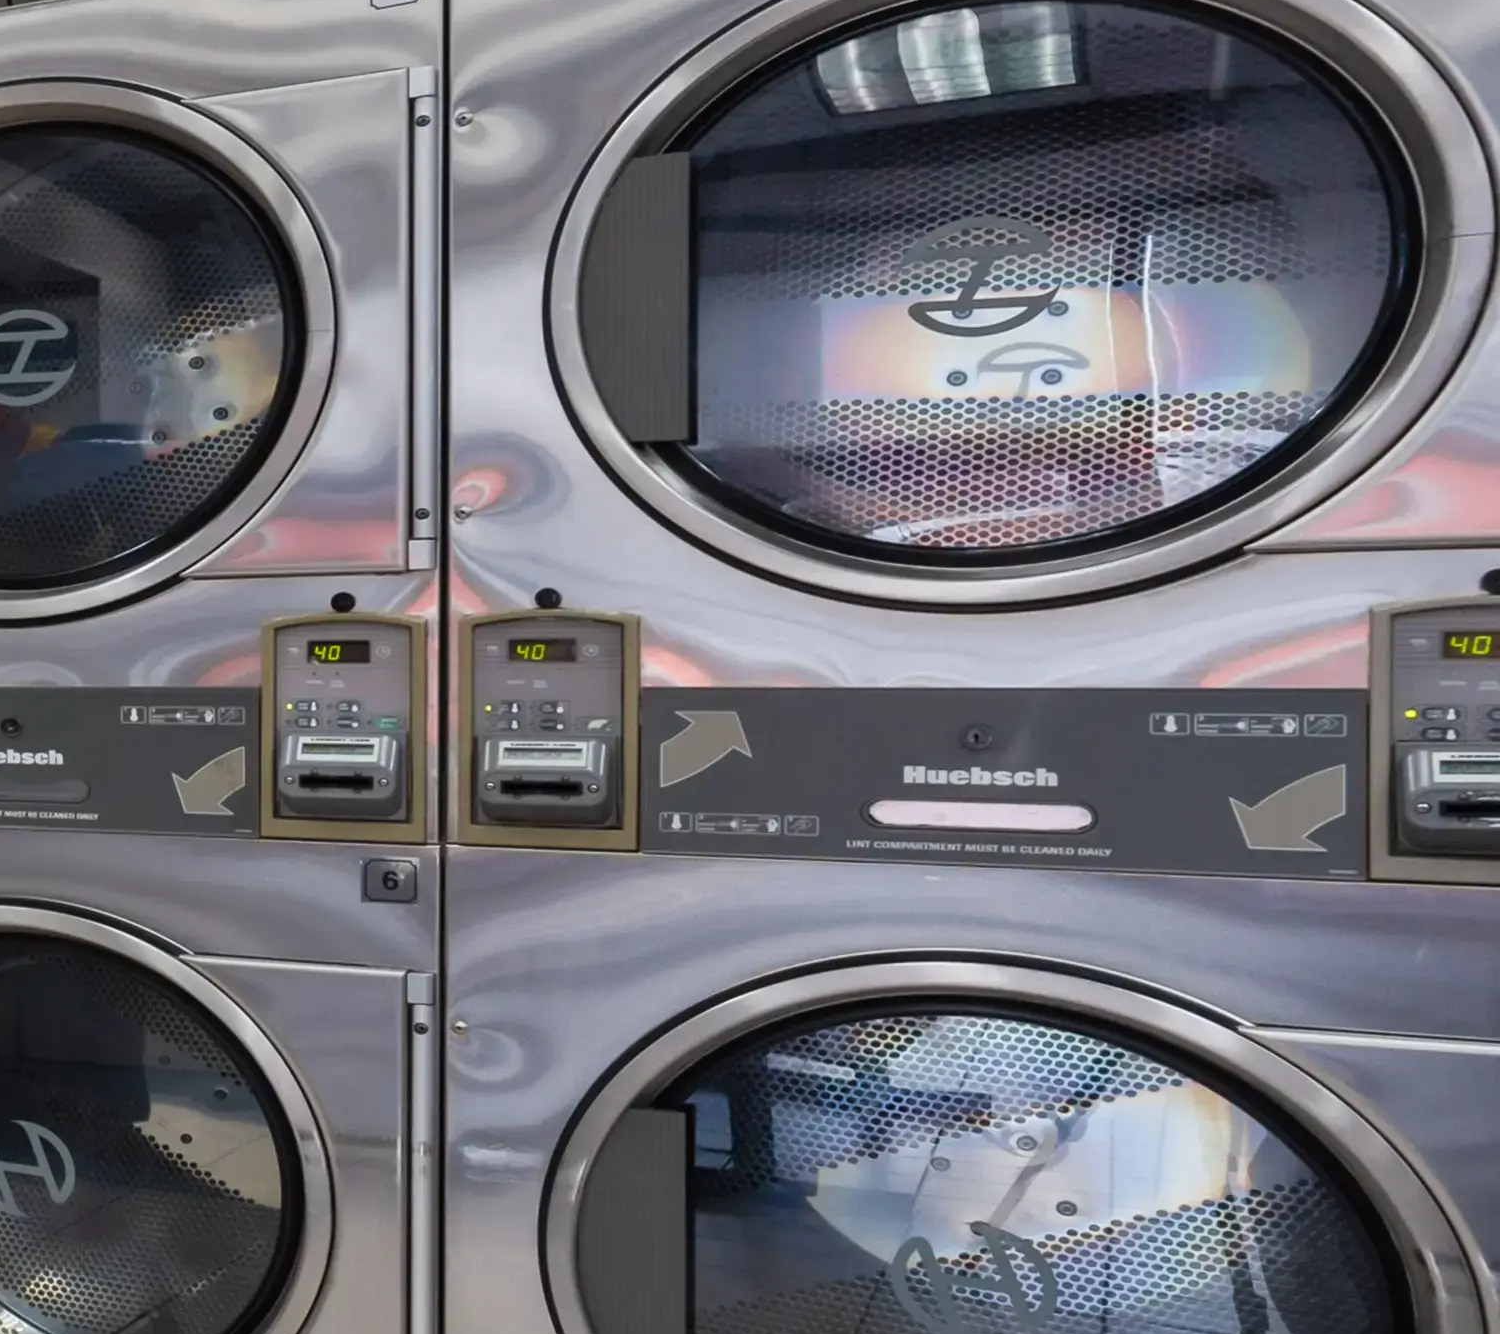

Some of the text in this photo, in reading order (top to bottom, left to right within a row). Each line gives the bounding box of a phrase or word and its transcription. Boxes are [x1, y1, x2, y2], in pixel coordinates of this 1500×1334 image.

[313, 643, 341, 662] 40
[515, 642, 546, 661] 40
[1448, 635, 1493, 656] 40
[903, 765, 1059, 787] Huebsch
[846, 839, 1112, 857] LINT COMPARTMENT MUST BE CLEANED DAILY
[380, 869, 399, 893] 6
